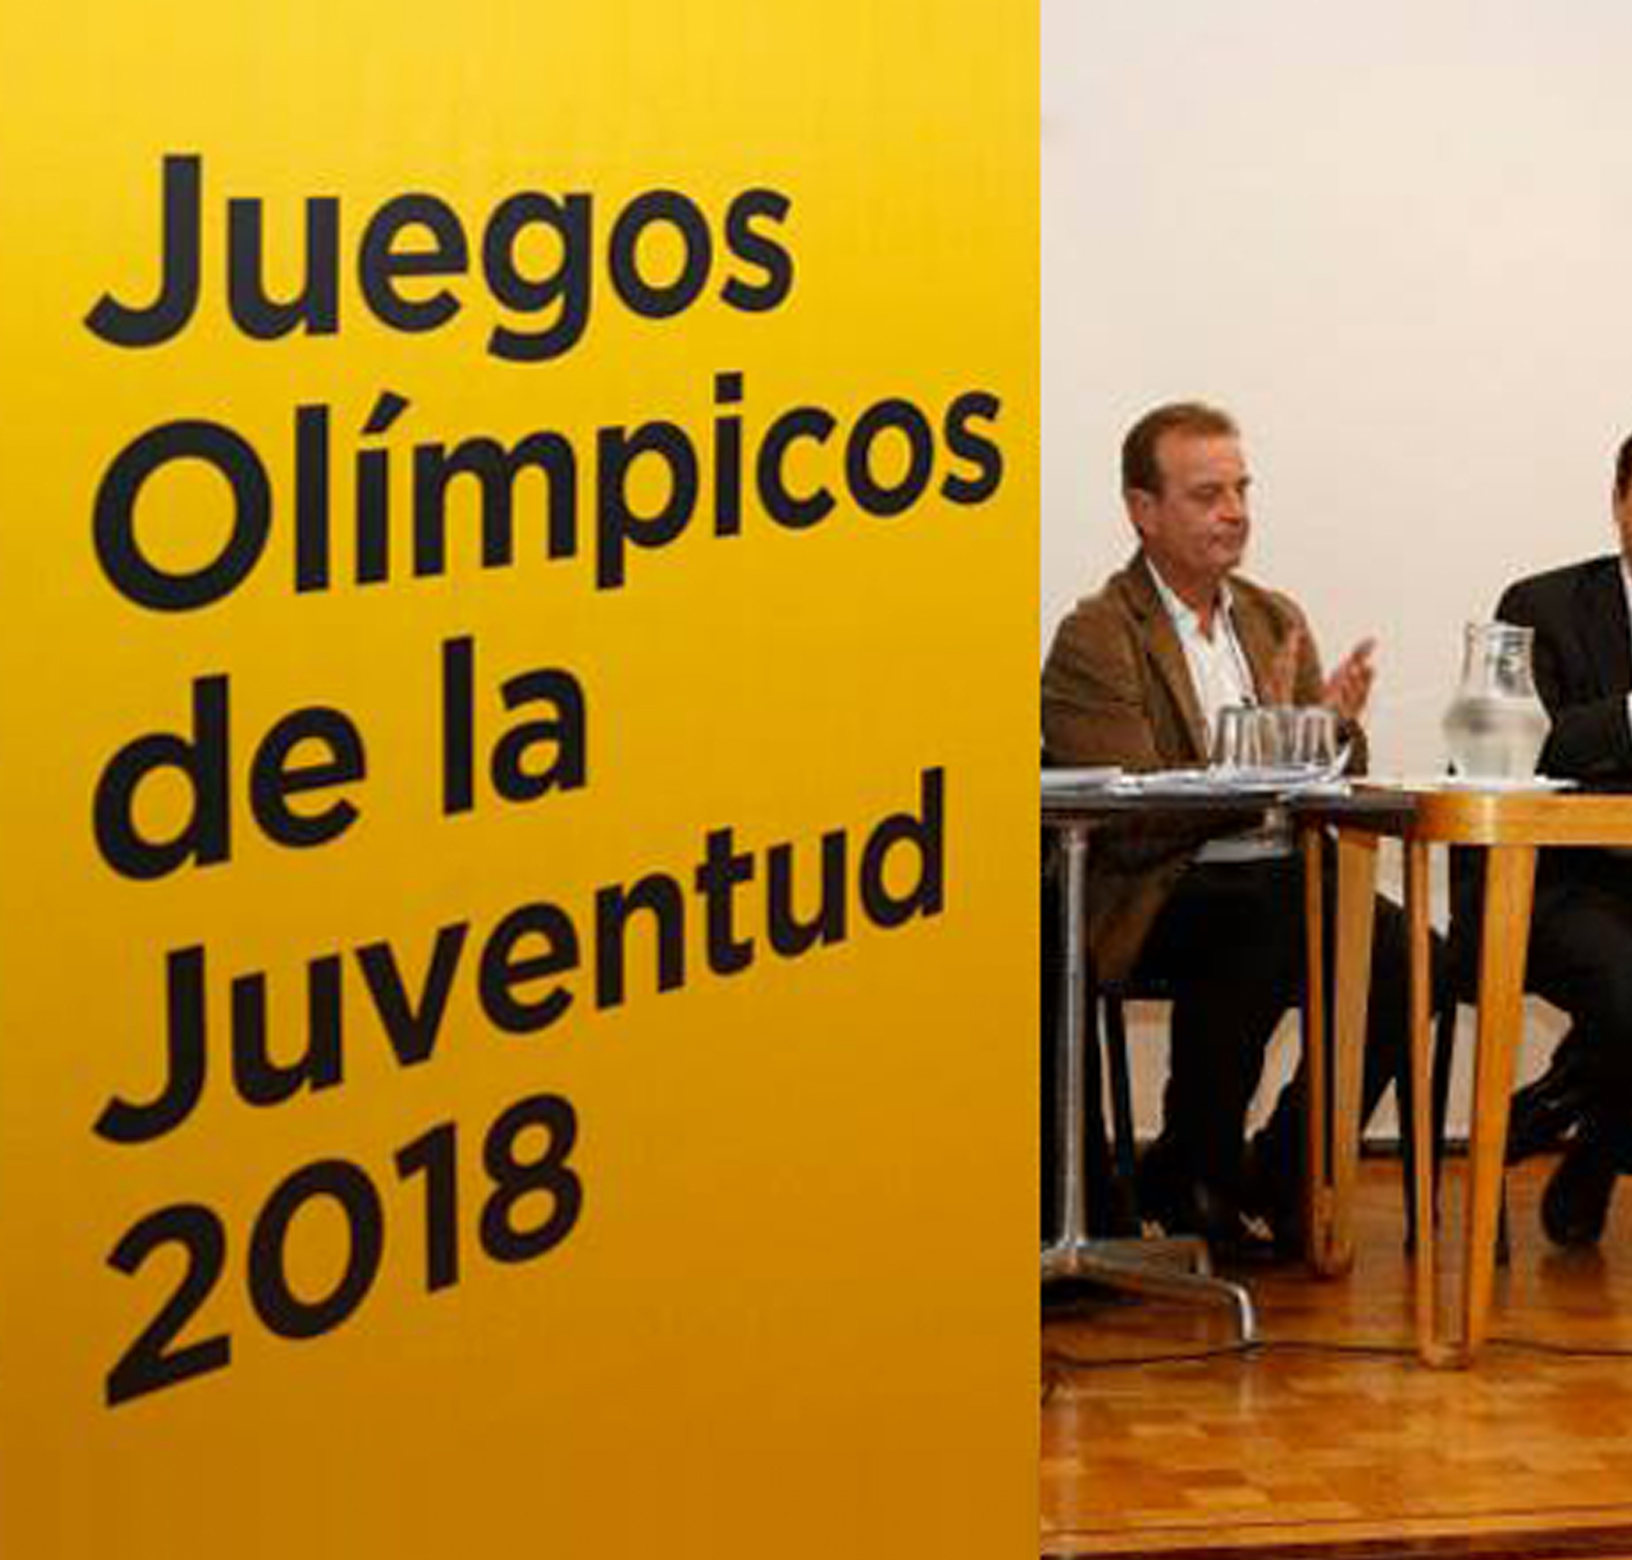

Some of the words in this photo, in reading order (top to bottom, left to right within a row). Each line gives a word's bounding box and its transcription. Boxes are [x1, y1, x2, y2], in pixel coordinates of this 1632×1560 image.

[84, 154, 793, 362] Juegos
[92, 371, 1004, 614] Olímpicos
[91, 674, 367, 882] de
[441, 636, 587, 816] la
[92, 766, 946, 1146] Juventud
[104, 1092, 584, 1408] 2018
